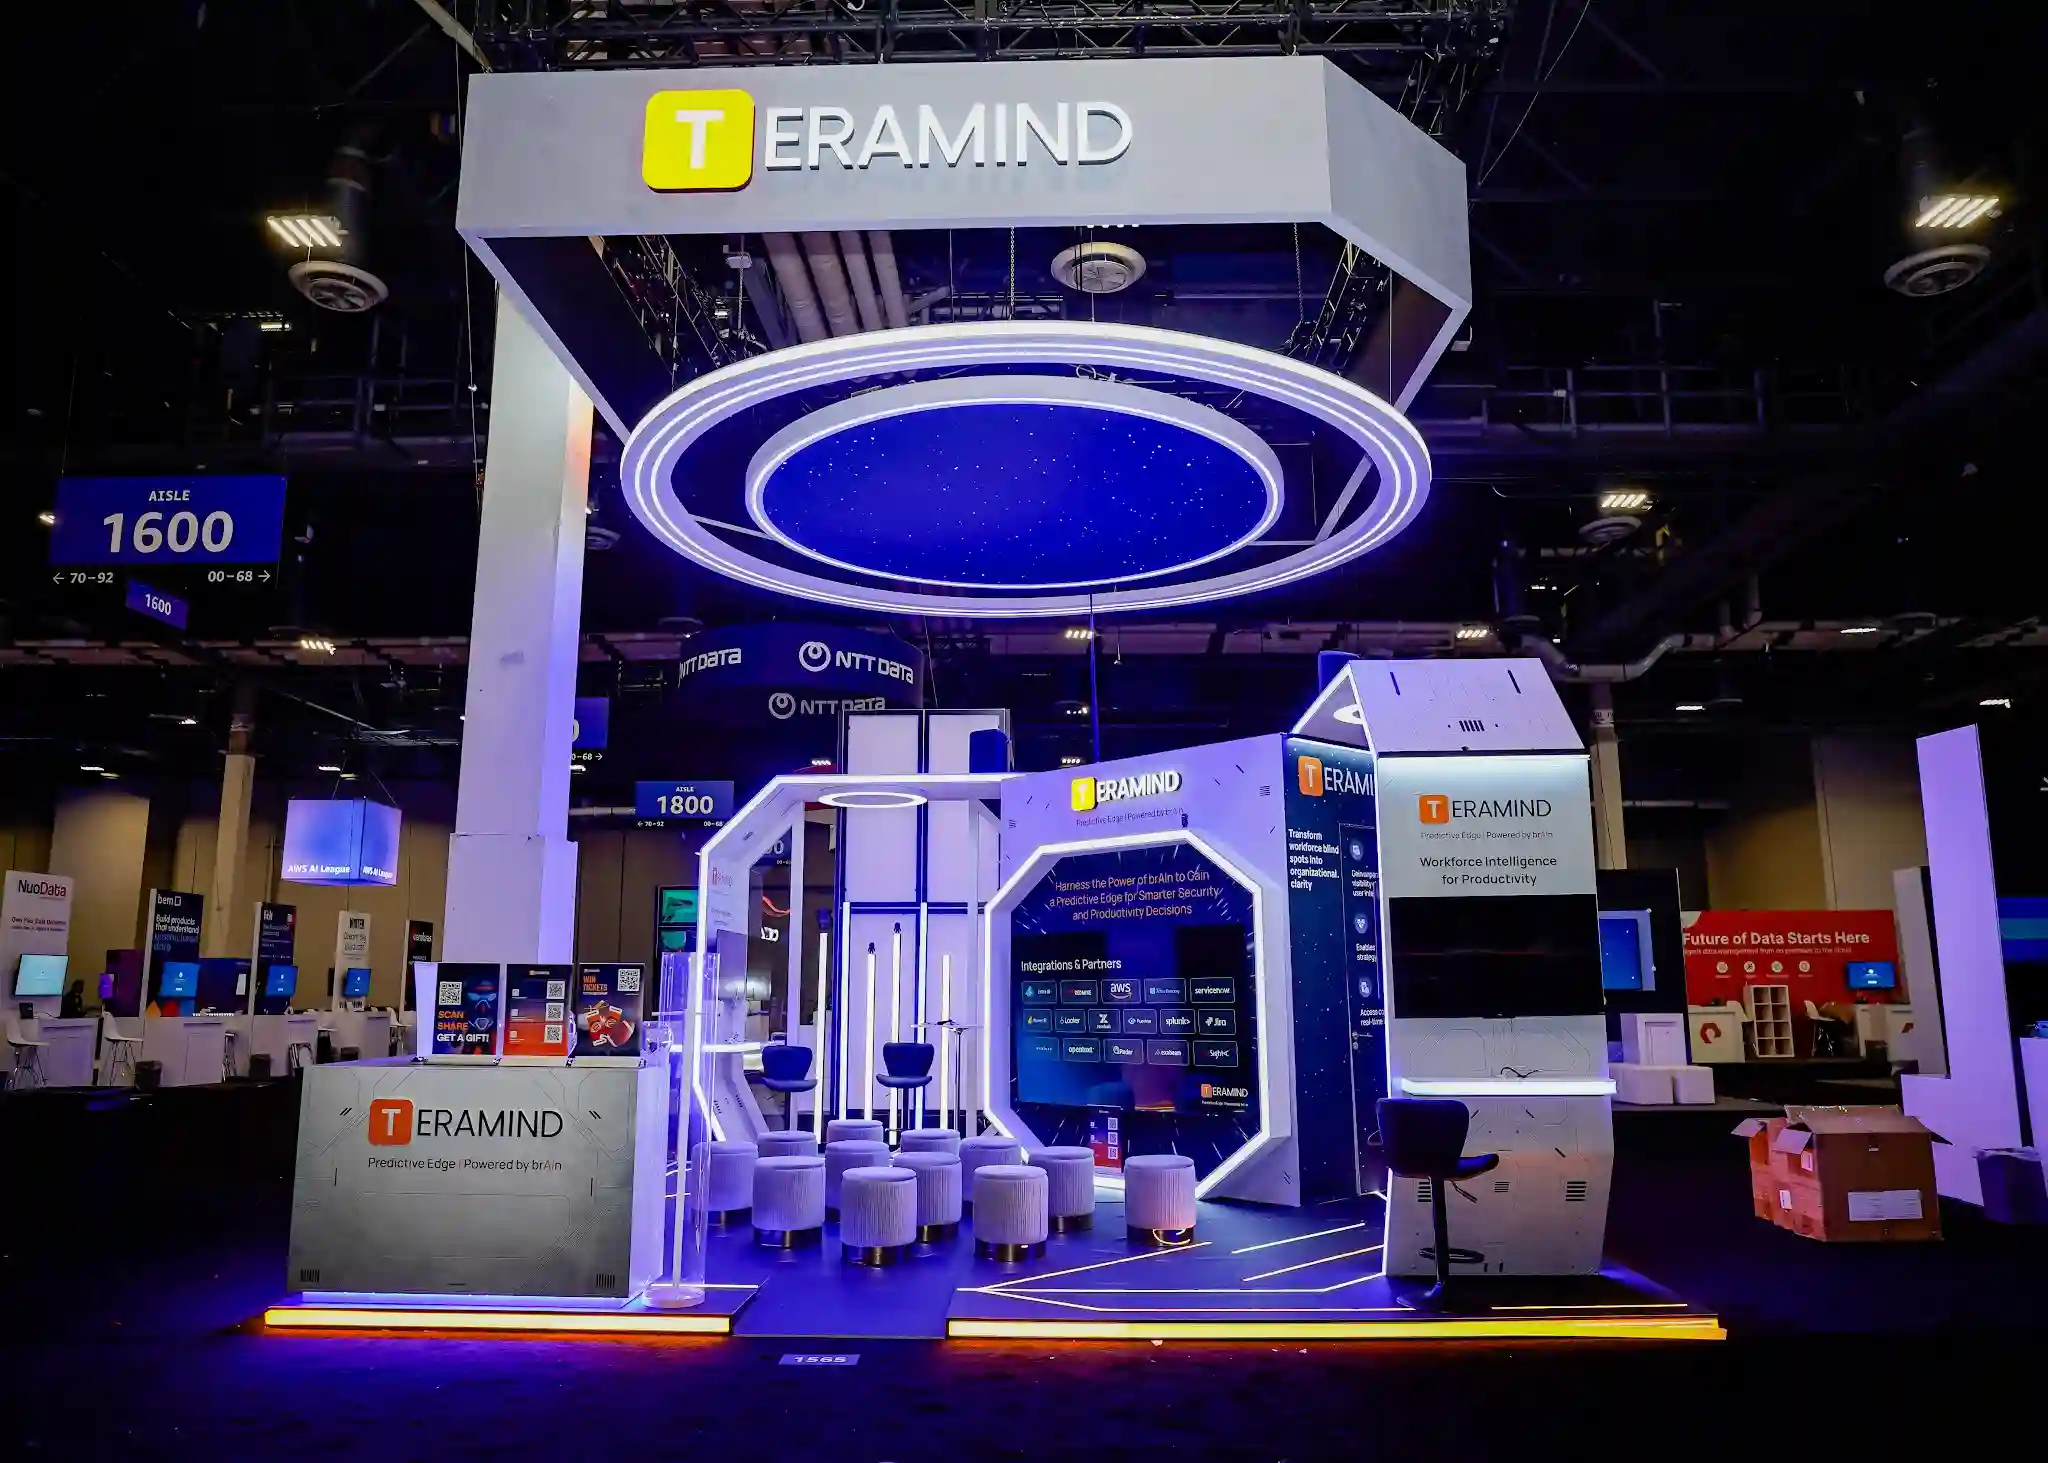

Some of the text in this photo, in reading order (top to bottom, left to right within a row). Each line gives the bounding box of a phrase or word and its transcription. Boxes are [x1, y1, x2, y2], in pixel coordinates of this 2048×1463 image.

[672, 99, 1134, 171] TERAMIND
[148, 490, 191, 502] AISLE
[103, 511, 234, 554] 1600
[70, 571, 253, 584] 70-92 00-68
[144, 593, 172, 616] 1600
[697, 647, 742, 671] DATA
[835, 650, 914, 685] NTT DATA
[800, 696, 886, 715] NTT DATA
[1075, 771, 1183, 804] TERAMIND
[657, 795, 714, 815] 1800
[1426, 799, 1552, 819] TERAMIND
[1288, 829, 1323, 841] Transform
[1461, 831, 1481, 841] Edge
[1486, 831, 1520, 839] Powered
[1521, 831, 1531, 841] by
[1289, 842, 1340, 855] workforce blind
[1289, 855, 1323, 866] spots into
[1420, 856, 1557, 870] Workforce Intelligence
[287, 863, 351, 876] AWS AI League
[362, 865, 373, 875] AWS
[1055, 879, 1091, 892] Harness
[1092, 878, 1107, 889] the
[1108, 876, 1137, 887] Power
[1138, 875, 1148, 886] of
[1175, 872, 1186, 882] to
[1187, 869, 1210, 881] Gain
[1290, 879, 1313, 892] clarity
[1441, 873, 1537, 887] for Productivity
[18, 879, 67, 897] NuoData
[1049, 885, 1220, 907] a Predictive Edge for Smarter Security
[1072, 904, 1193, 921] and Productivity Decisions
[1683, 931, 1870, 946] Future of Data Starts Here
[1020, 958, 1122, 974] Integrations & Partners
[583, 975, 596, 984] WIN
[583, 983, 608, 992] TICKETS
[1110, 983, 1131, 994] aws
[438, 1010, 465, 1019] SCAN
[437, 1022, 468, 1031] SHARE
[436, 1033, 490, 1043] GET A GIFT!
[1203, 1086, 1249, 1098] TERAMIND
[381, 1107, 564, 1138] TERAMIND
[367, 1157, 425, 1169] Predictive
[427, 1158, 456, 1171] Edge
[463, 1159, 514, 1170] Powered
[516, 1159, 530, 1173] by
